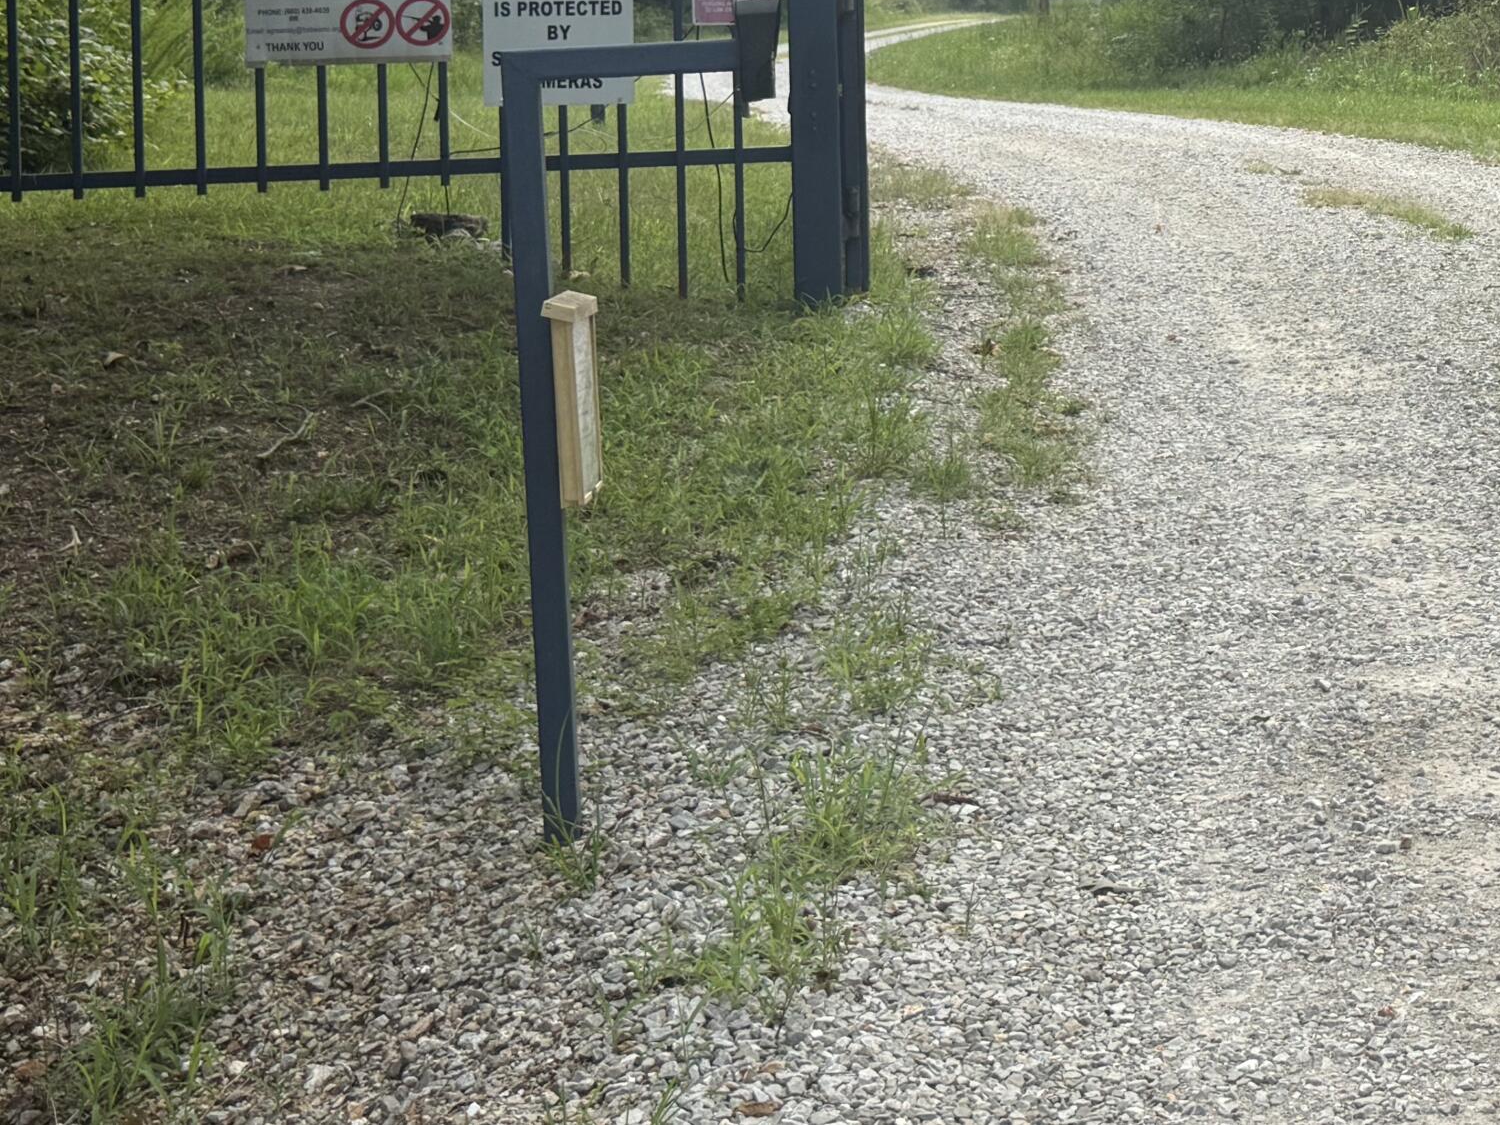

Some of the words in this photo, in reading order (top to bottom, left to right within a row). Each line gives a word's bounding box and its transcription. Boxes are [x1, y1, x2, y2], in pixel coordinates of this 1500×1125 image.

[494, 2, 511, 17] IS
[517, 0, 623, 17] PROTECTED
[547, 25, 571, 40] BY
[265, 42, 301, 52] THANK
[303, 41, 325, 51] YOU
[541, 77, 603, 89] MERAS
